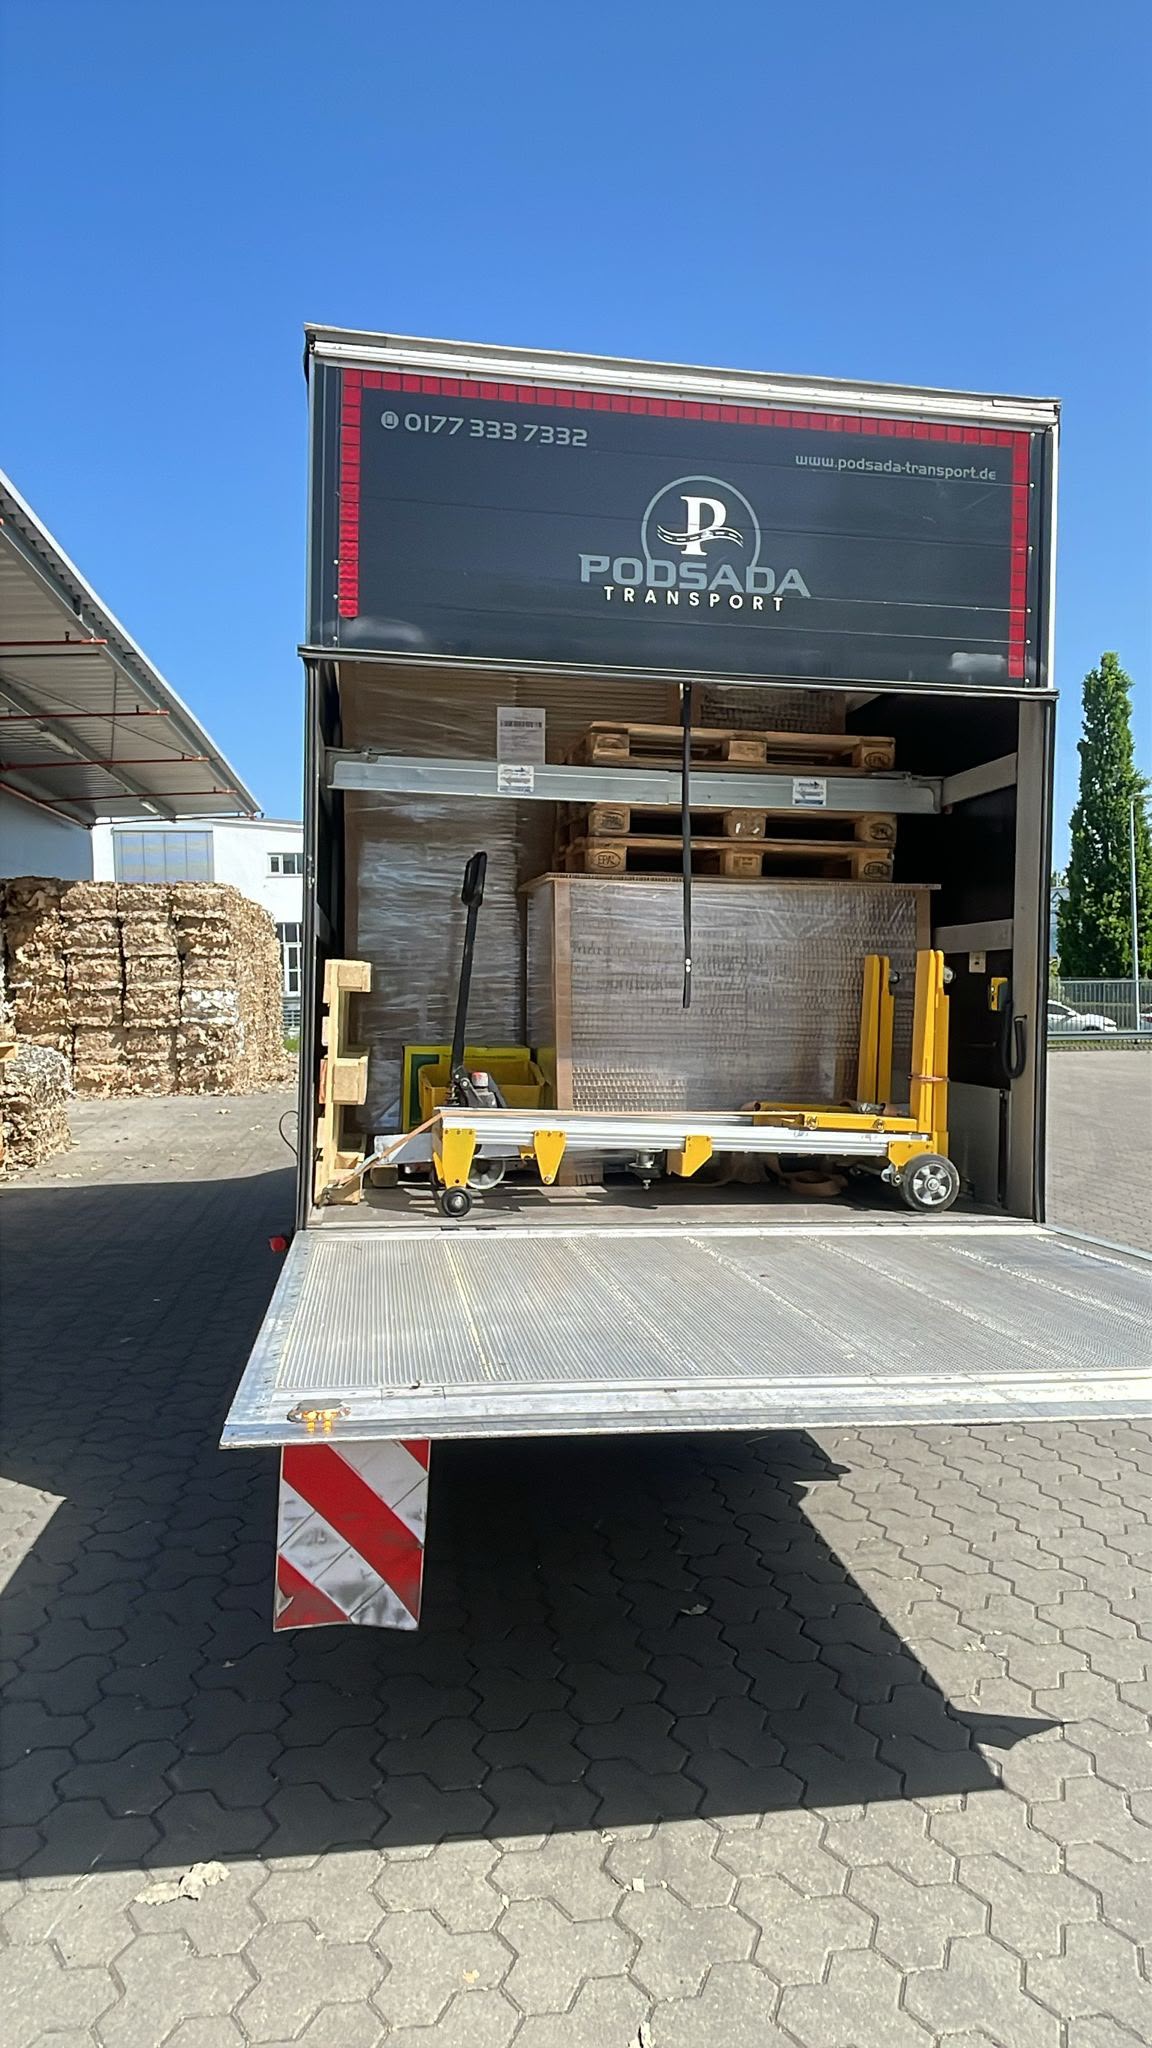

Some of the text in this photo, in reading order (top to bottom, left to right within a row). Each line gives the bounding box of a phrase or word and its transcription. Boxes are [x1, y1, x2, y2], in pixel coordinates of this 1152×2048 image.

[404, 413, 587, 447] 0177 333 7332
[795, 455, 996, 480] www.podsada-transport.de
[680, 495, 727, 556] P
[578, 553, 812, 599] PODSADA
[603, 586, 784, 612] TRANSPORT
